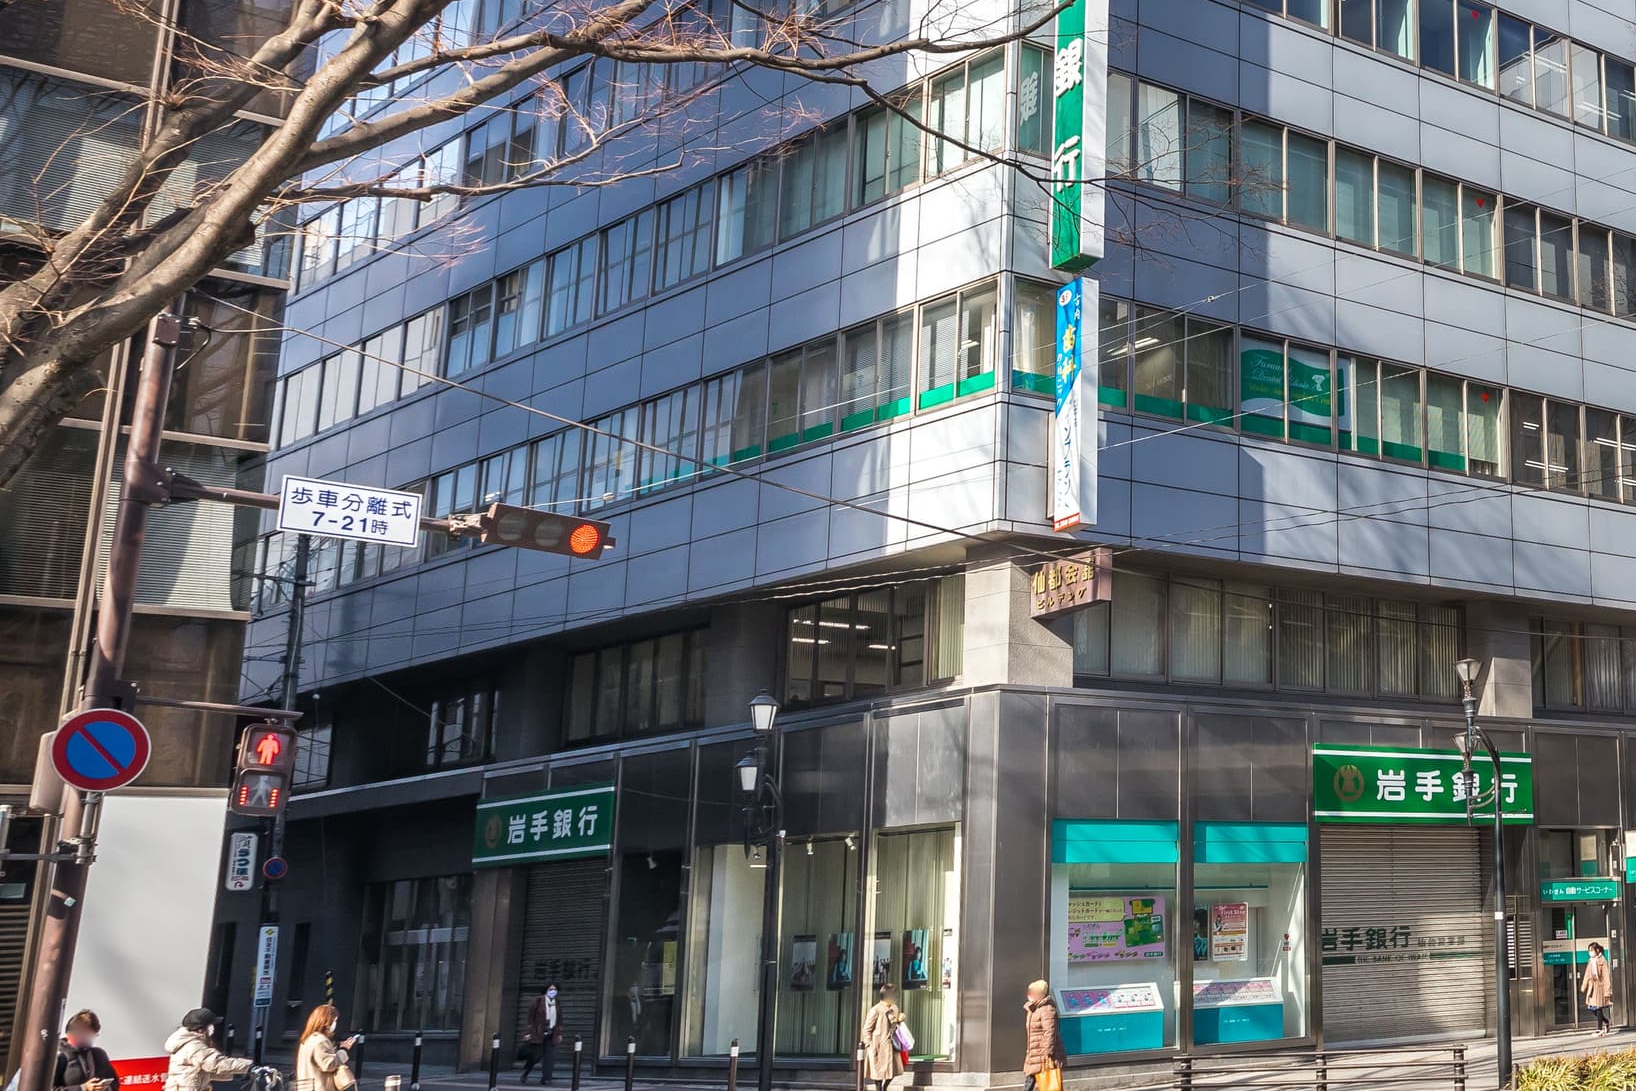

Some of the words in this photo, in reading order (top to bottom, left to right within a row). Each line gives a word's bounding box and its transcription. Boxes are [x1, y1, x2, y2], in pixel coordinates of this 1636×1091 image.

[291, 487, 412, 519] 歩車分離式
[311, 511, 389, 535] 7-21時
[1376, 769, 1518, 803] 岩手銀行
[507, 806, 598, 844] 岩手銀行
[1322, 926, 1412, 951] 岩手銀行
